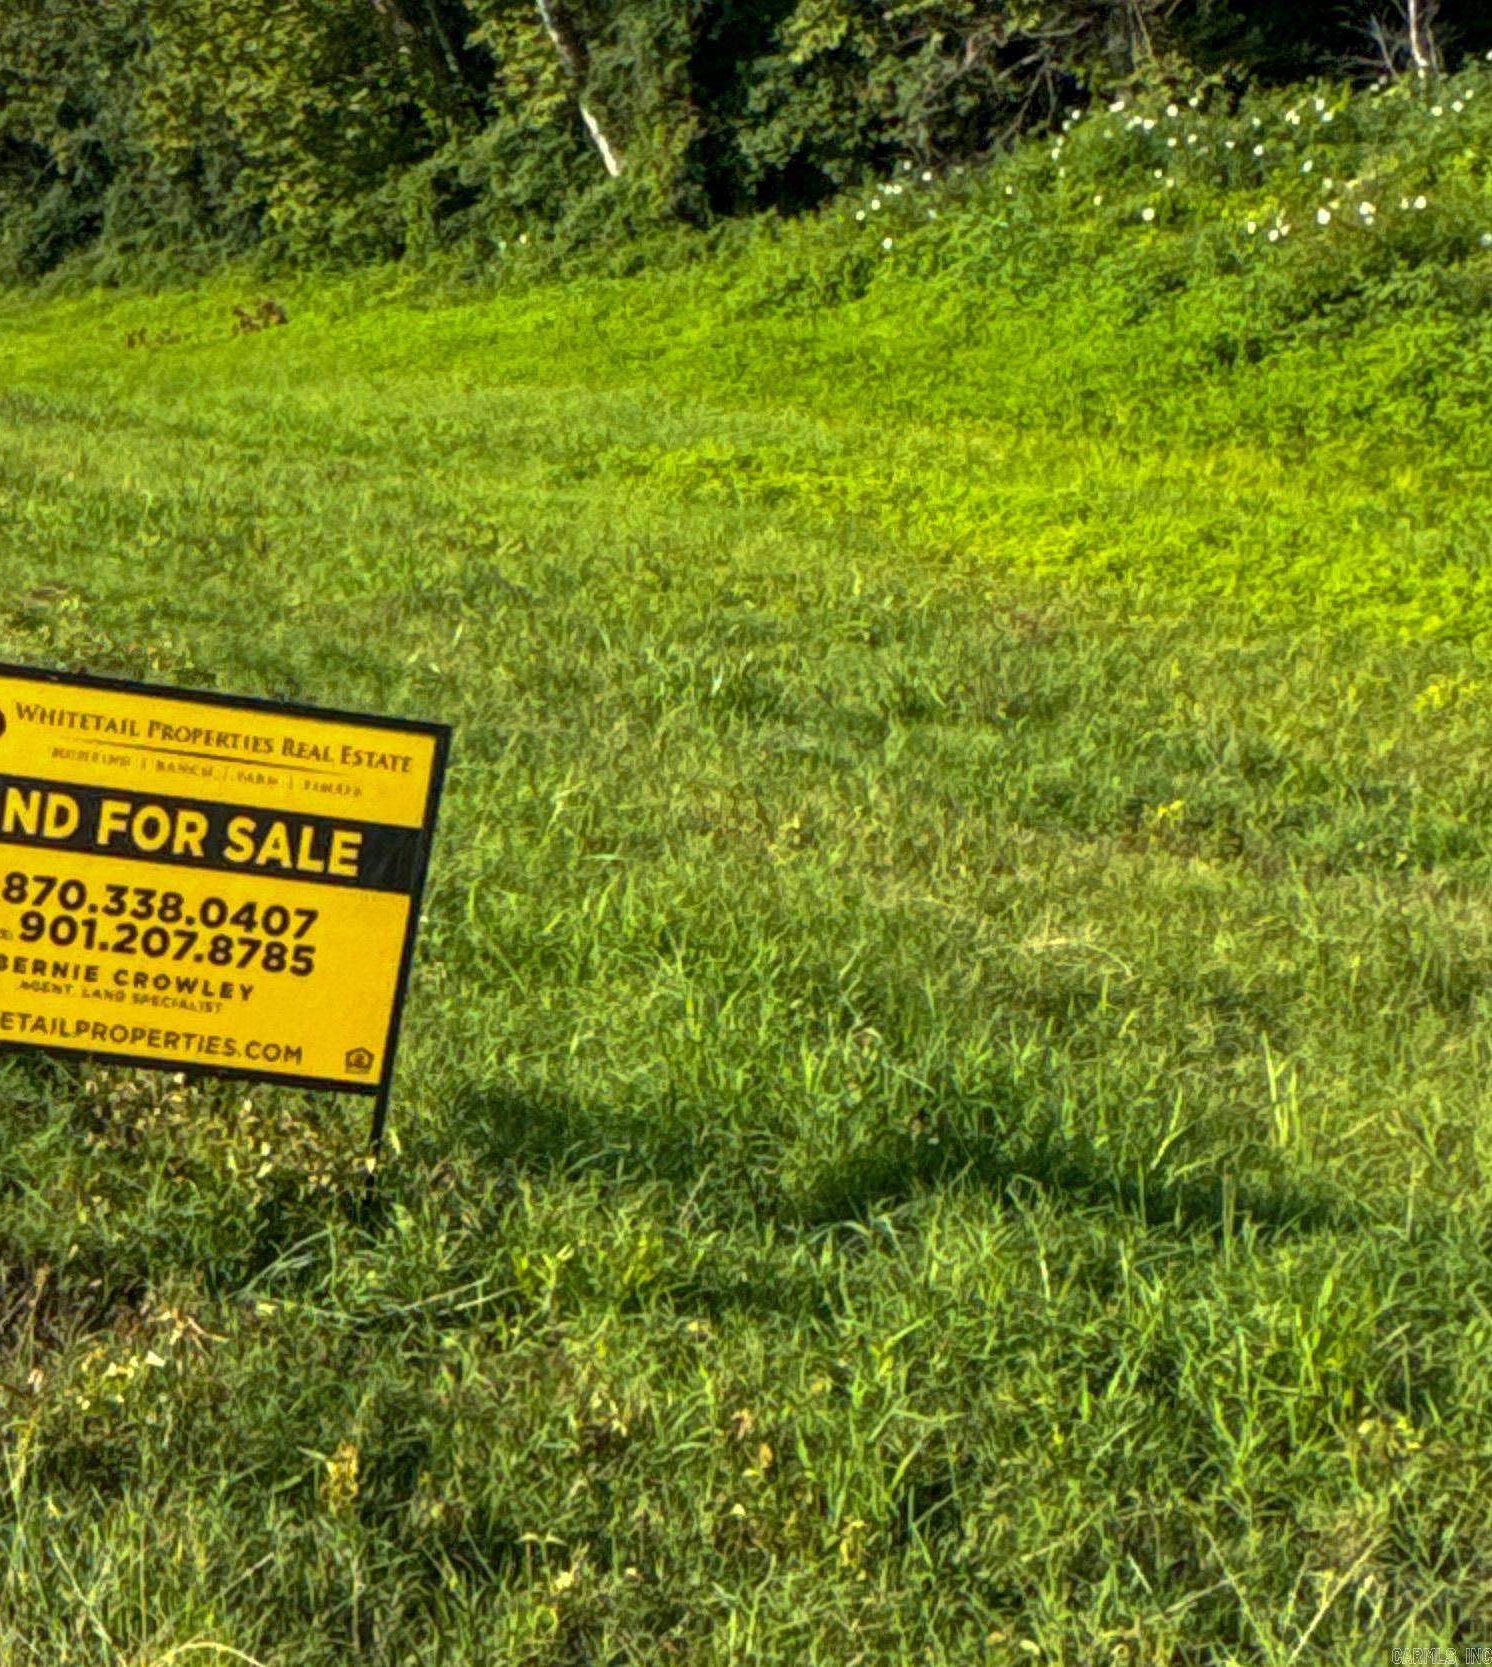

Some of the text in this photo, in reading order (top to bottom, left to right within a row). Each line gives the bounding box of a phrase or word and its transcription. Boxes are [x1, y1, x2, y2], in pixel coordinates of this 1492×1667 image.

[282, 737, 333, 763] REAL
[342, 745, 413, 773] ESTATE
[96, 801, 205, 857] FOR
[225, 820, 363, 877] SALE
[2, 872, 320, 939] 870.338.0407
[19, 910, 317, 978] 901.207.8785
[113, 969, 255, 1002] CROWLEY
